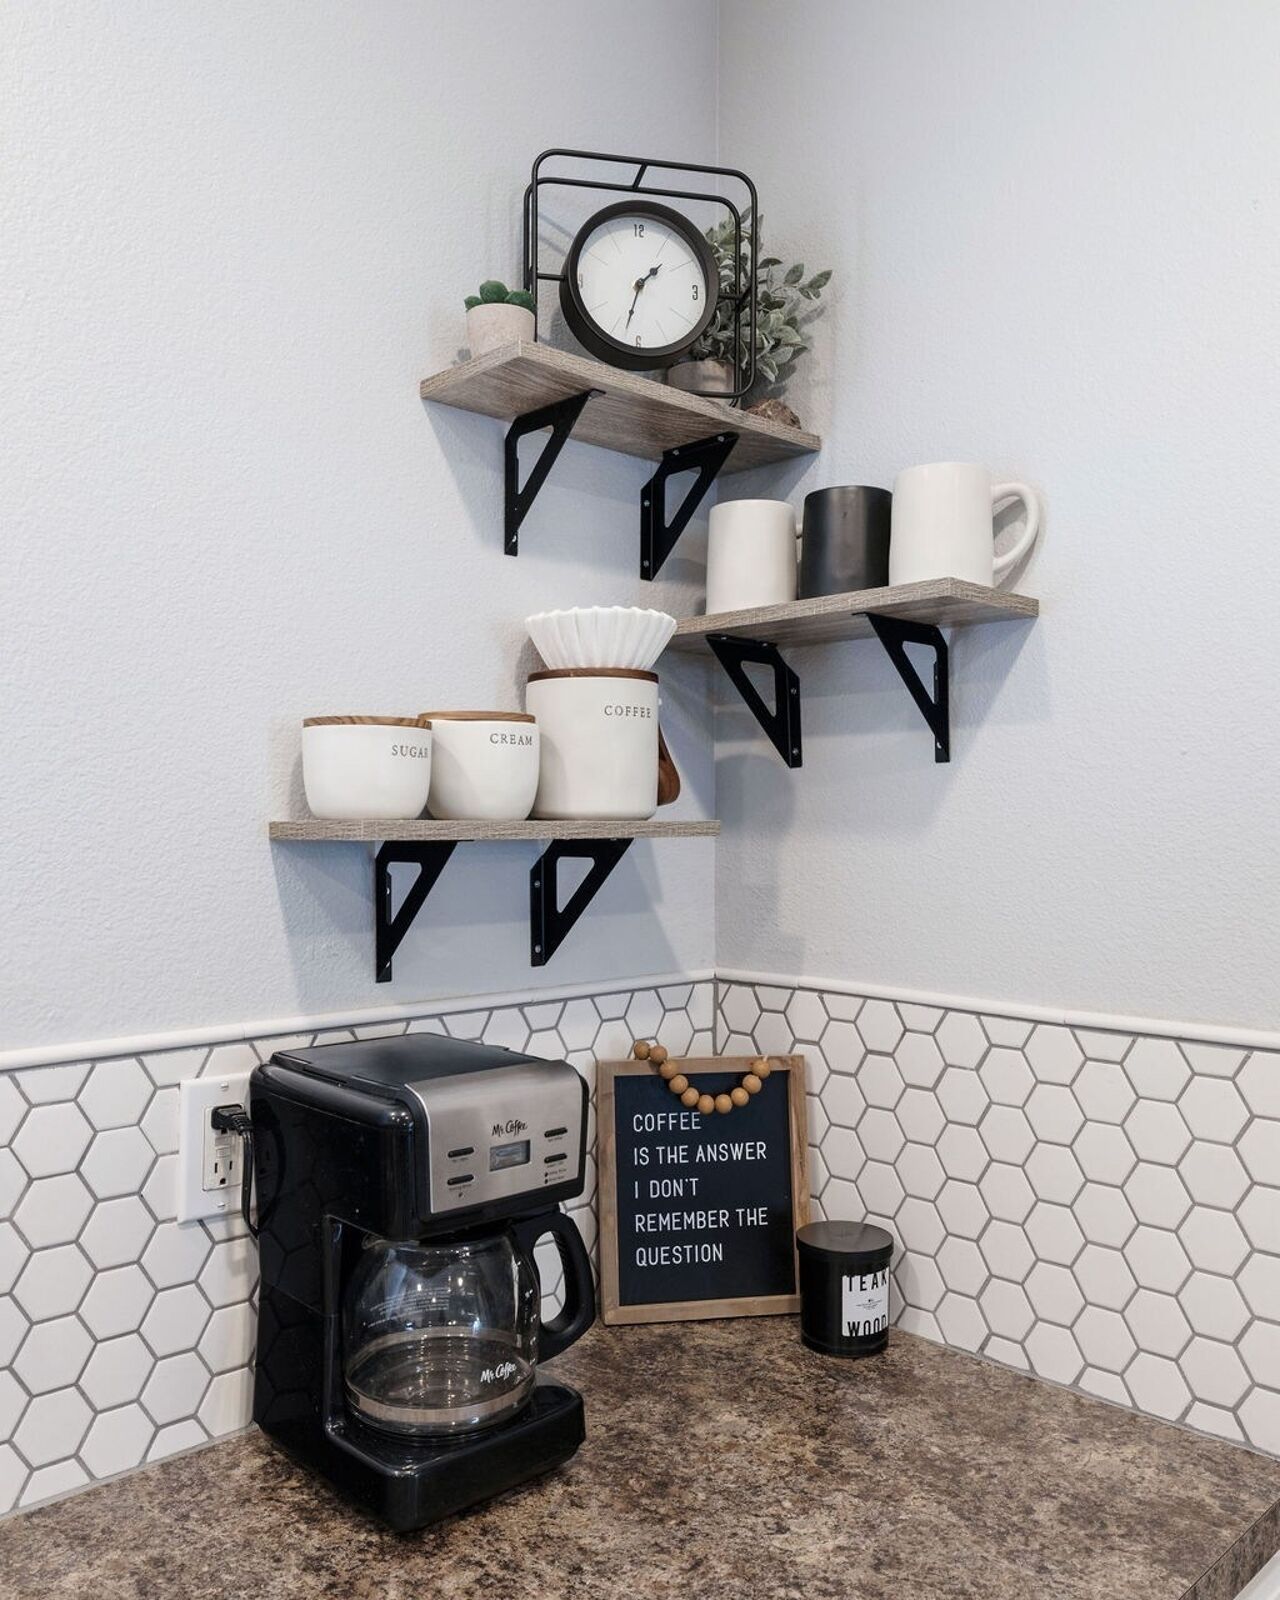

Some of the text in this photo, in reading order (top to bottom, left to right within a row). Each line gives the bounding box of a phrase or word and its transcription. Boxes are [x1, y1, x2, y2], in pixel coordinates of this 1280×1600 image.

[633, 223, 645, 238] 12
[691, 284, 699, 301] 3
[635, 335, 642, 347] 6
[604, 704, 651, 718] COFFEE
[489, 732, 533, 746] CREAM
[505, 1119, 528, 1136] Coffee
[632, 1112, 701, 1132] COFFEE
[633, 1141, 767, 1166] IS THE ANSWER
[634, 1178, 699, 1199] I DON'T
[634, 1207, 769, 1233] REMEMBER THE
[635, 1243, 724, 1267] QUESTION
[495, 1361, 517, 1381] Coffee
